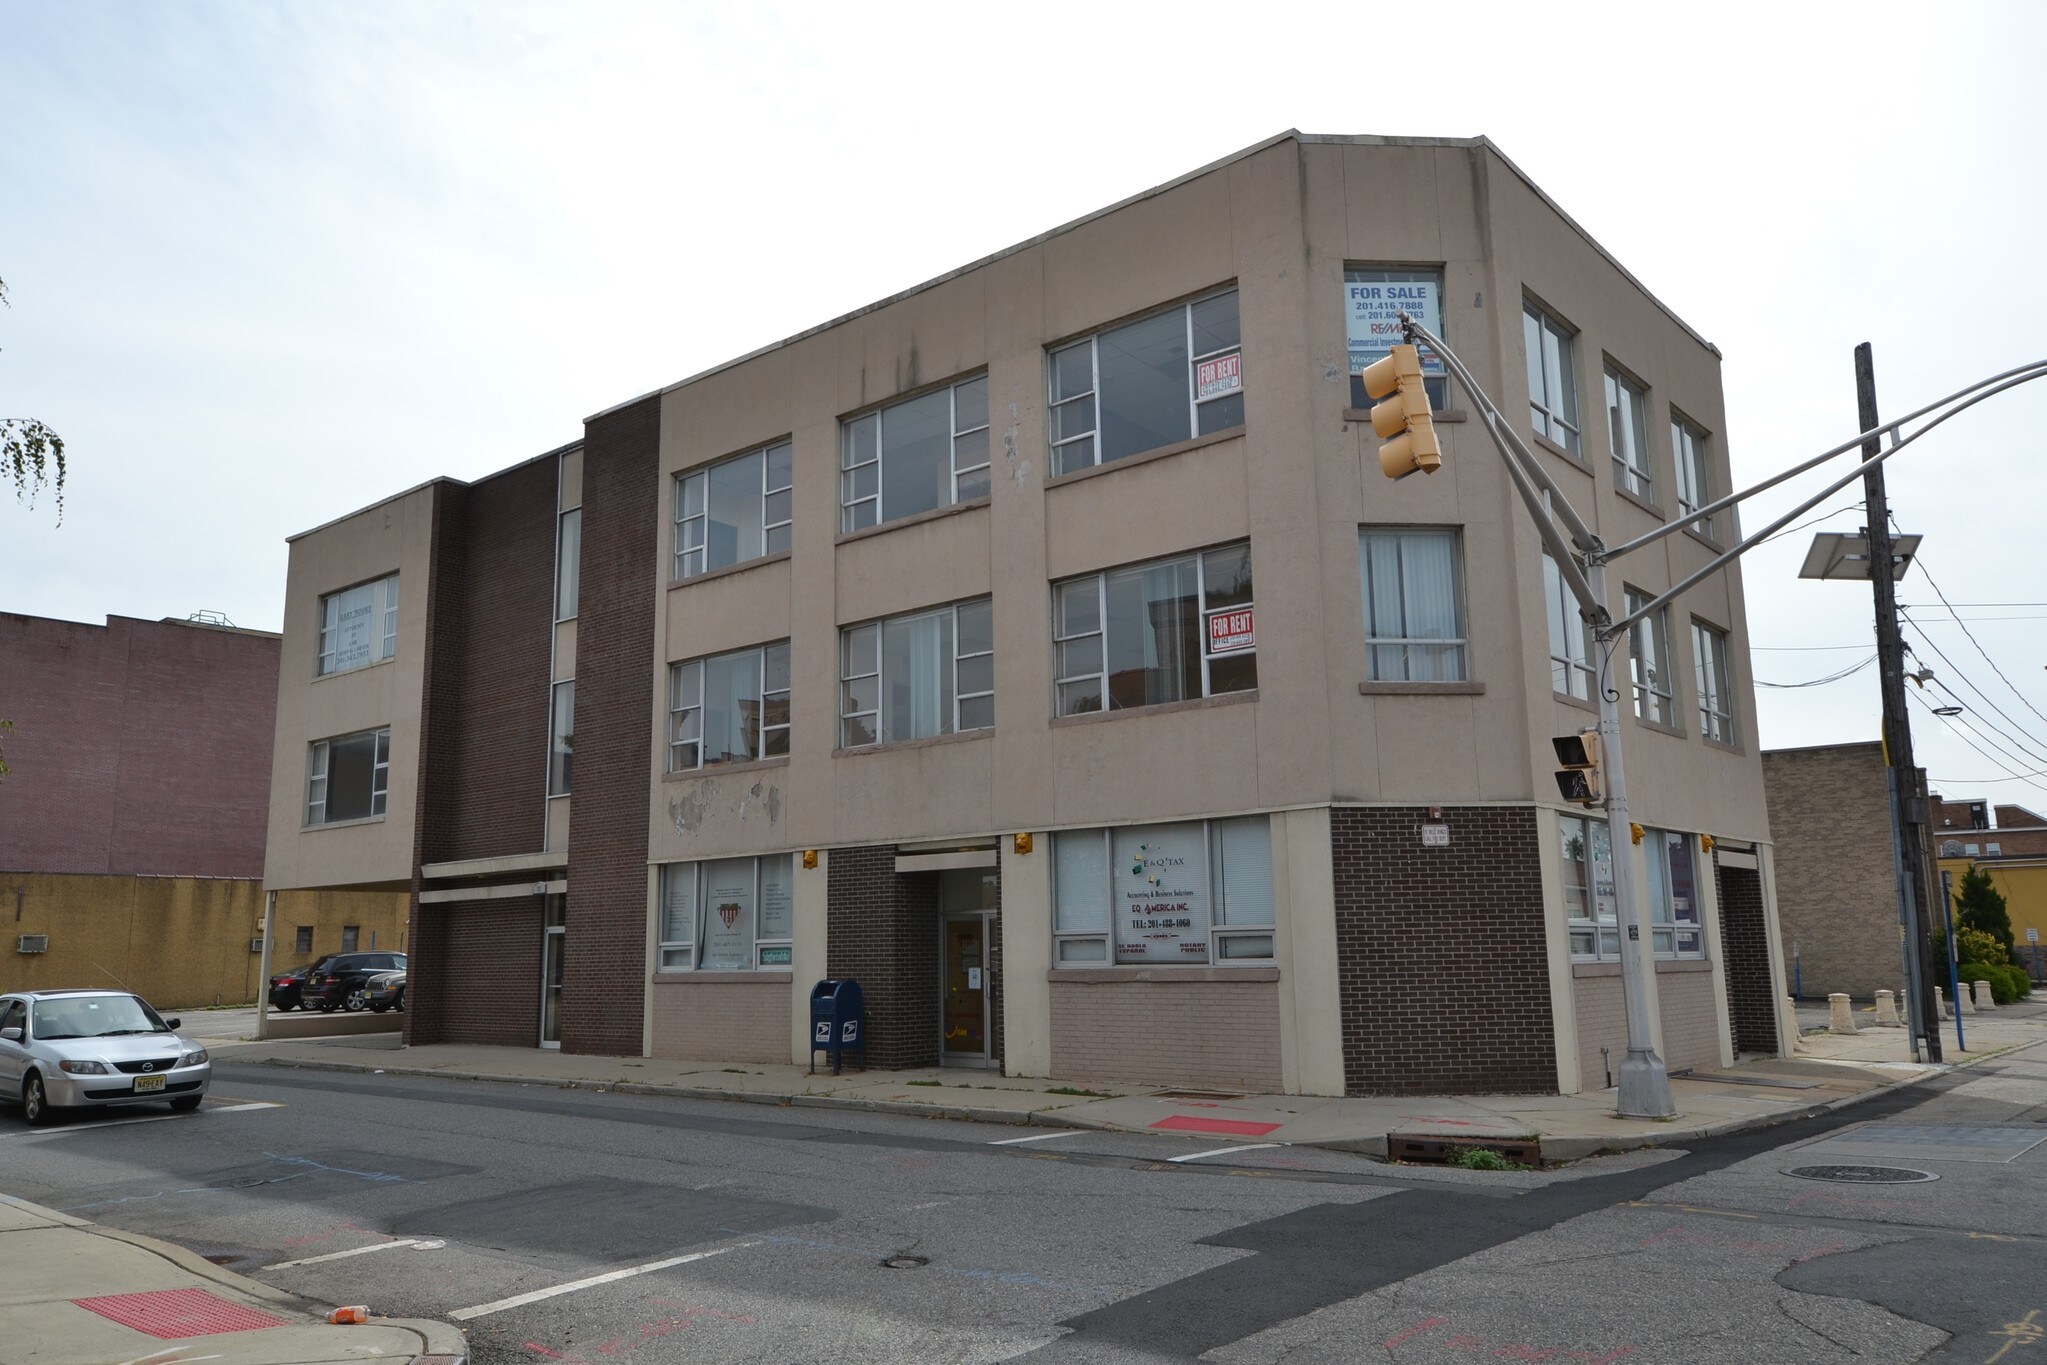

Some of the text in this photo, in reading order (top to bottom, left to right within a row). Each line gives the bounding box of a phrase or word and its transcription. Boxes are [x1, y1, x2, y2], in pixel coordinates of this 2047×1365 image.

[1350, 287, 1427, 299] FOR SALE
[1356, 301, 1424, 310] 201.416.7888
[1348, 337, 1379, 347] Commercial
[1201, 357, 1237, 384] FOR RENT
[1213, 614, 1250, 636] FOR RENT
[1127, 890, 1150, 899] Accounting
[1155, 890, 1172, 898] Business
[1173, 888, 1194, 897] Solutions
[1131, 904, 1141, 913] EQ
[1176, 902, 1189, 912] INC.
[1132, 919, 1147, 929] TEL:
